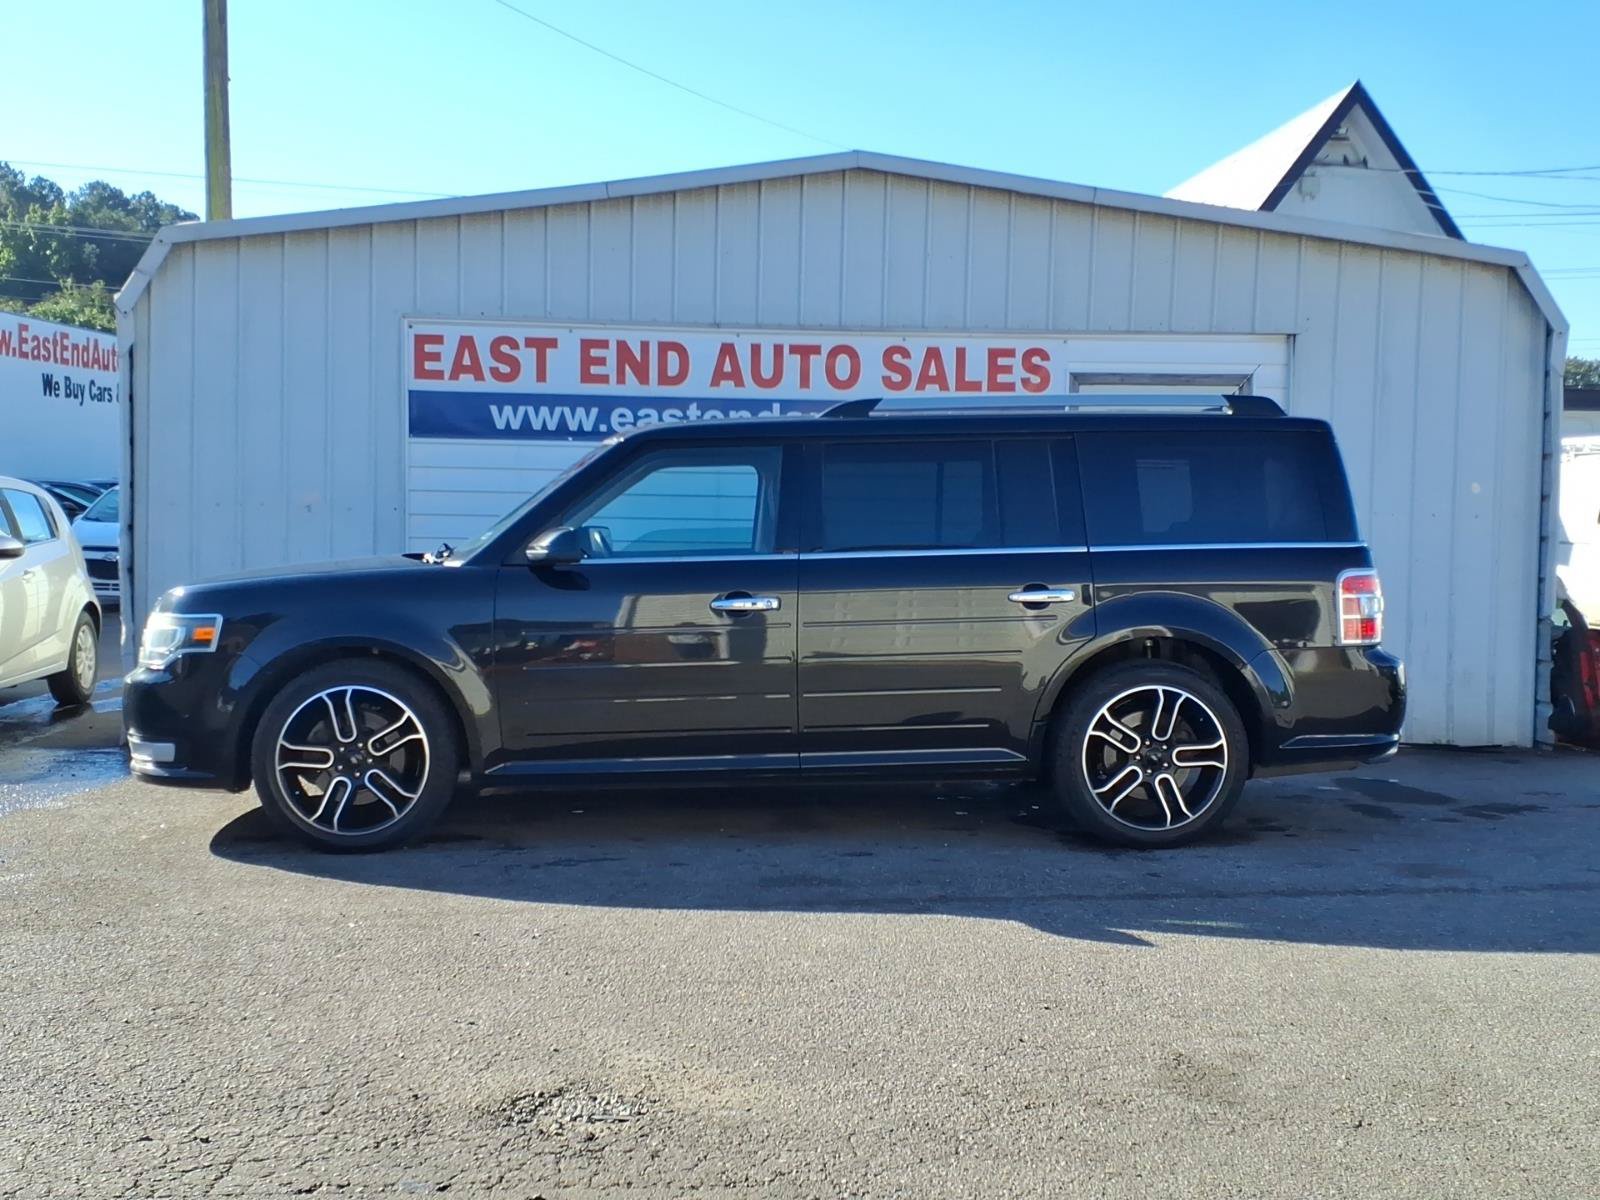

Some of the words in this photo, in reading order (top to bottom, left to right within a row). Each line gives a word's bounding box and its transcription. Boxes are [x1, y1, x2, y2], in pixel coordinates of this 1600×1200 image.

[0, 323, 118, 372] w.EastEndAut
[413, 334, 558, 383] EAST
[580, 338, 690, 387] END
[709, 342, 861, 391] AUTO
[881, 345, 1052, 393] SALES
[42, 373, 60, 398] We
[64, 376, 85, 406] Buy
[89, 379, 113, 403] Cars
